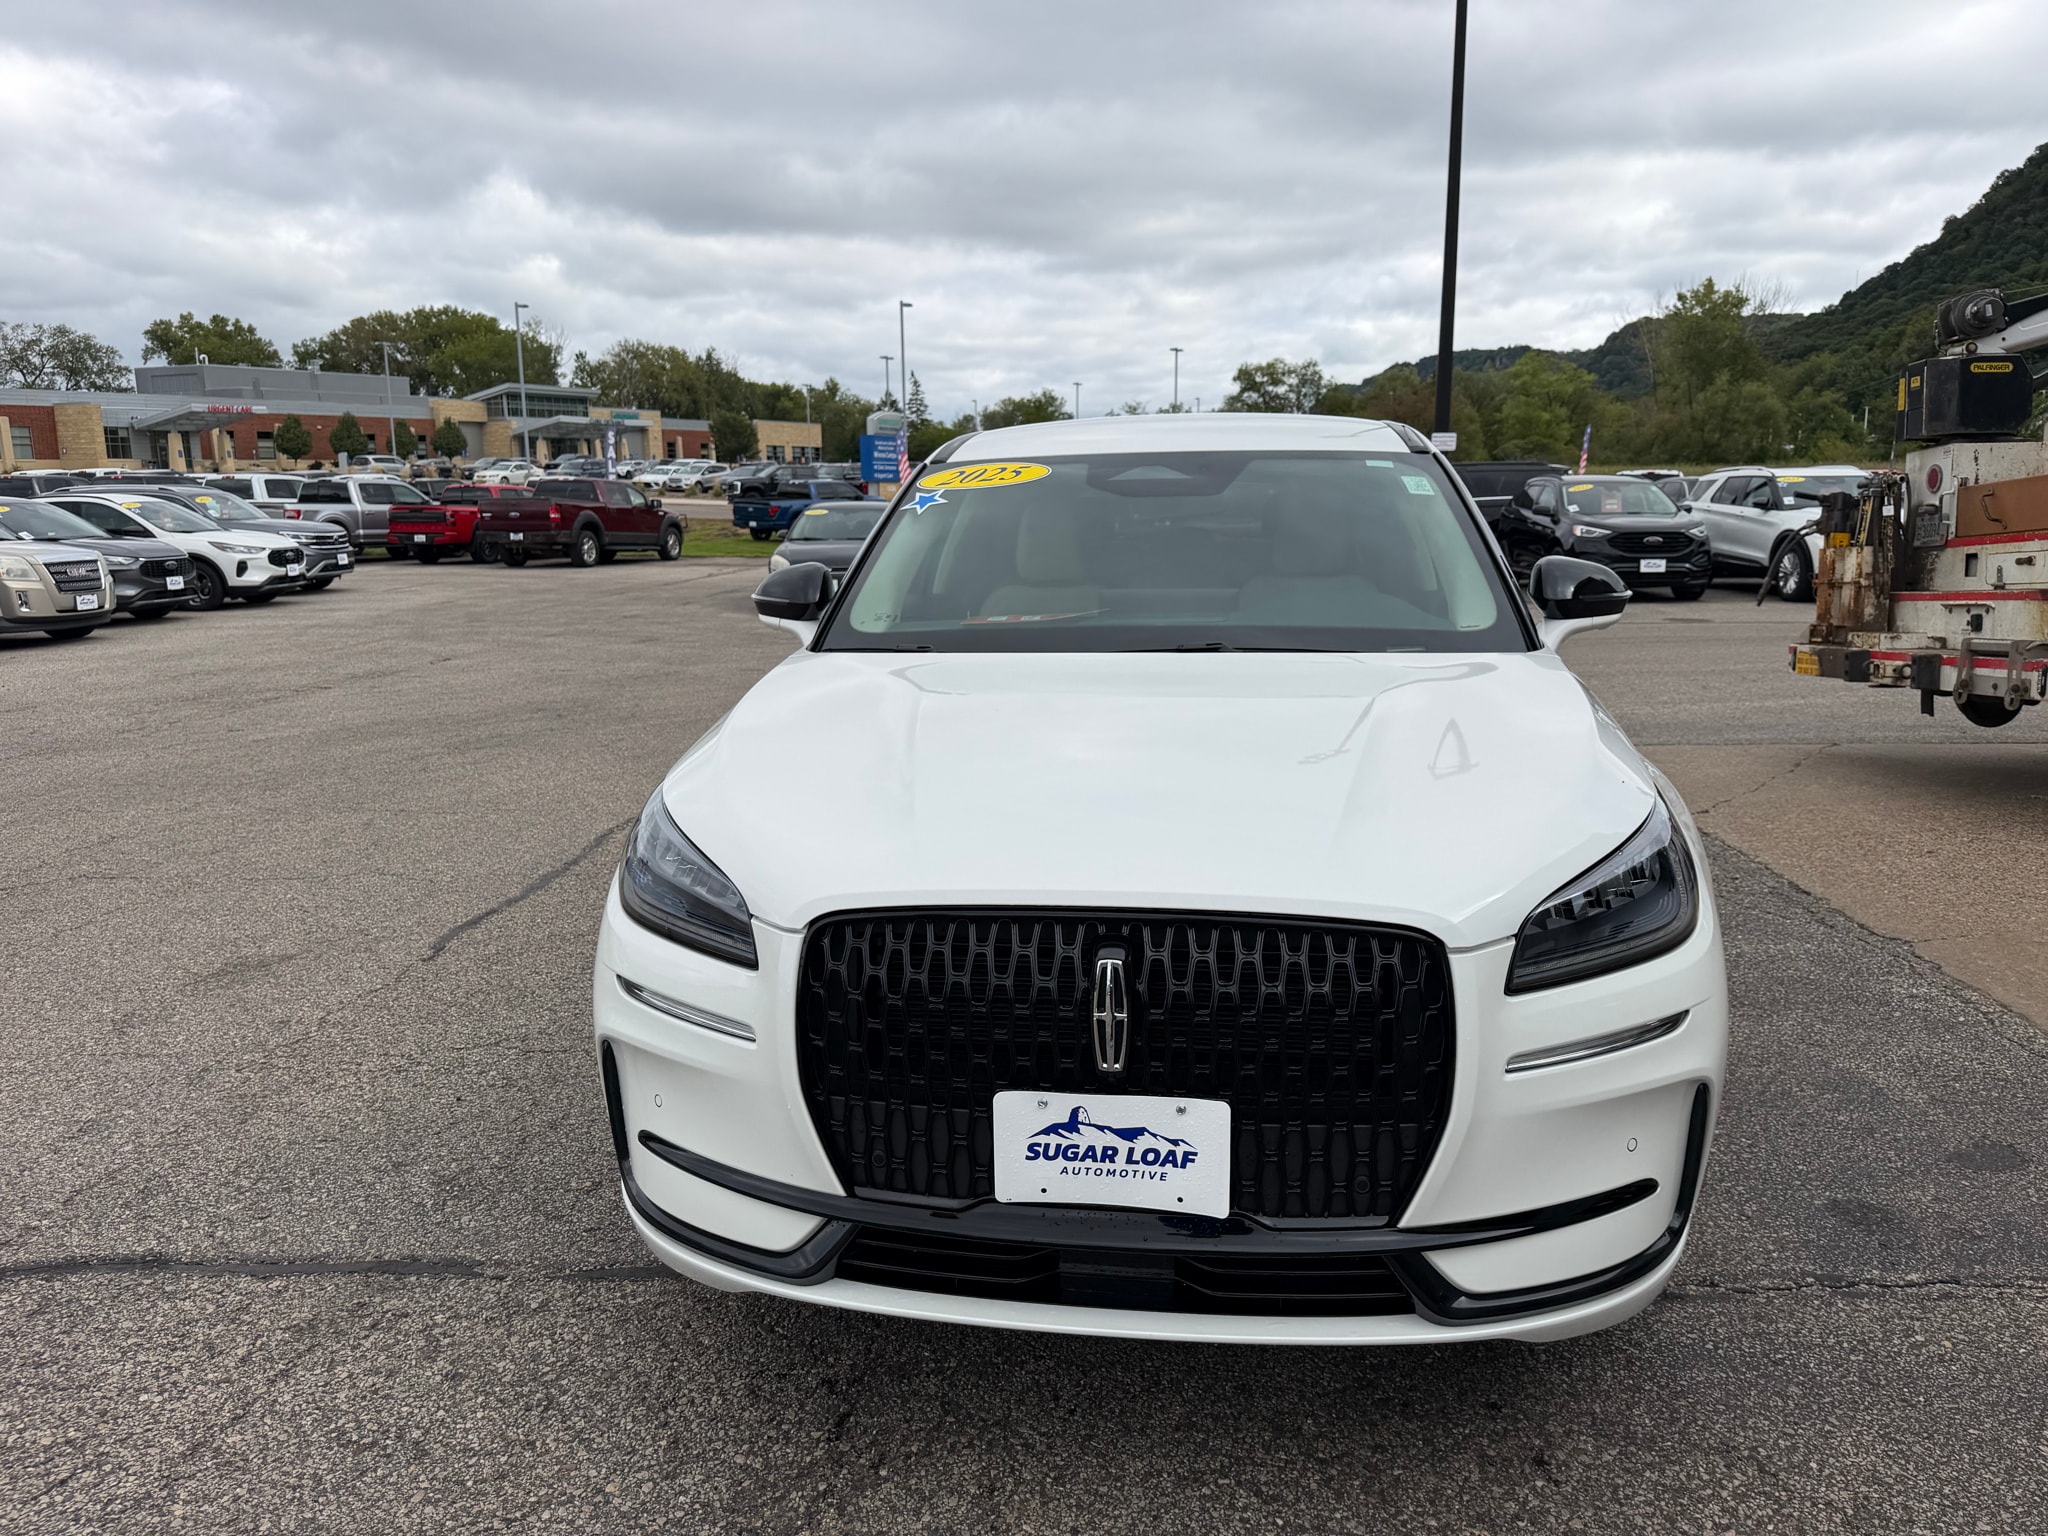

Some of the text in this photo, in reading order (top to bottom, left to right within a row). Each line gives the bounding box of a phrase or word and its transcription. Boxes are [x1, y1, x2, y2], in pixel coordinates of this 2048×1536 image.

[935, 465, 1031, 487] 2025
[1025, 1142, 1199, 1169] SUGAR LOAF
[1060, 1166, 1169, 1182] AUTOMOTIVE
